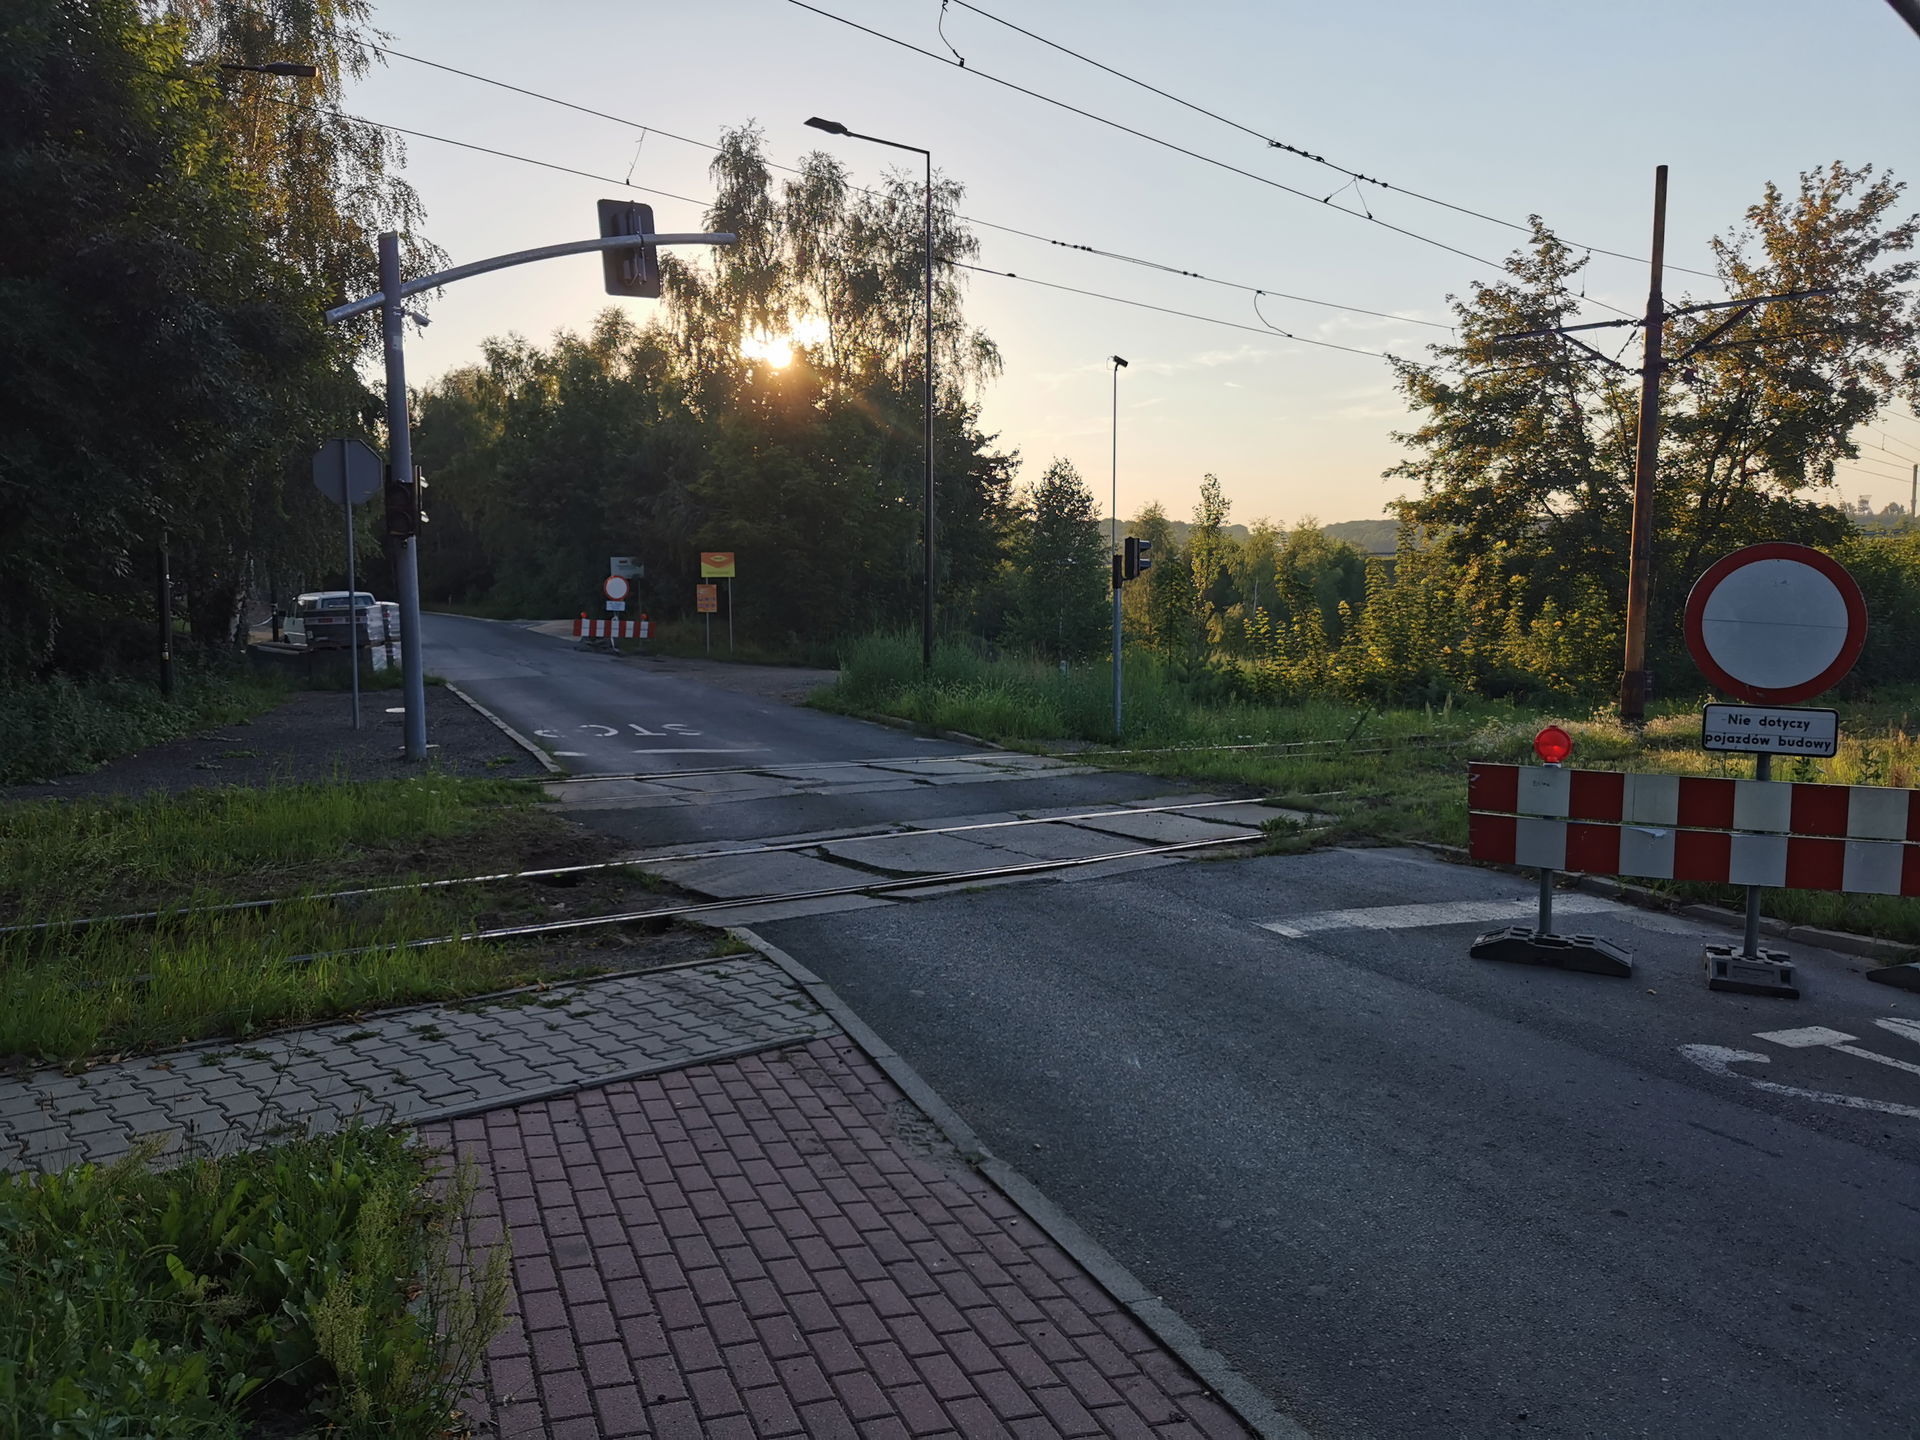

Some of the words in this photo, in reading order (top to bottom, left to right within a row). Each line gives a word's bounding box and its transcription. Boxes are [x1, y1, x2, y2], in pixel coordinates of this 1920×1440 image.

[1727, 714, 1751, 726] Nie
[1758, 716, 1810, 732] dotyczy
[1705, 732, 1770, 746] pojazdów
[1778, 736, 1832, 752] budowy
